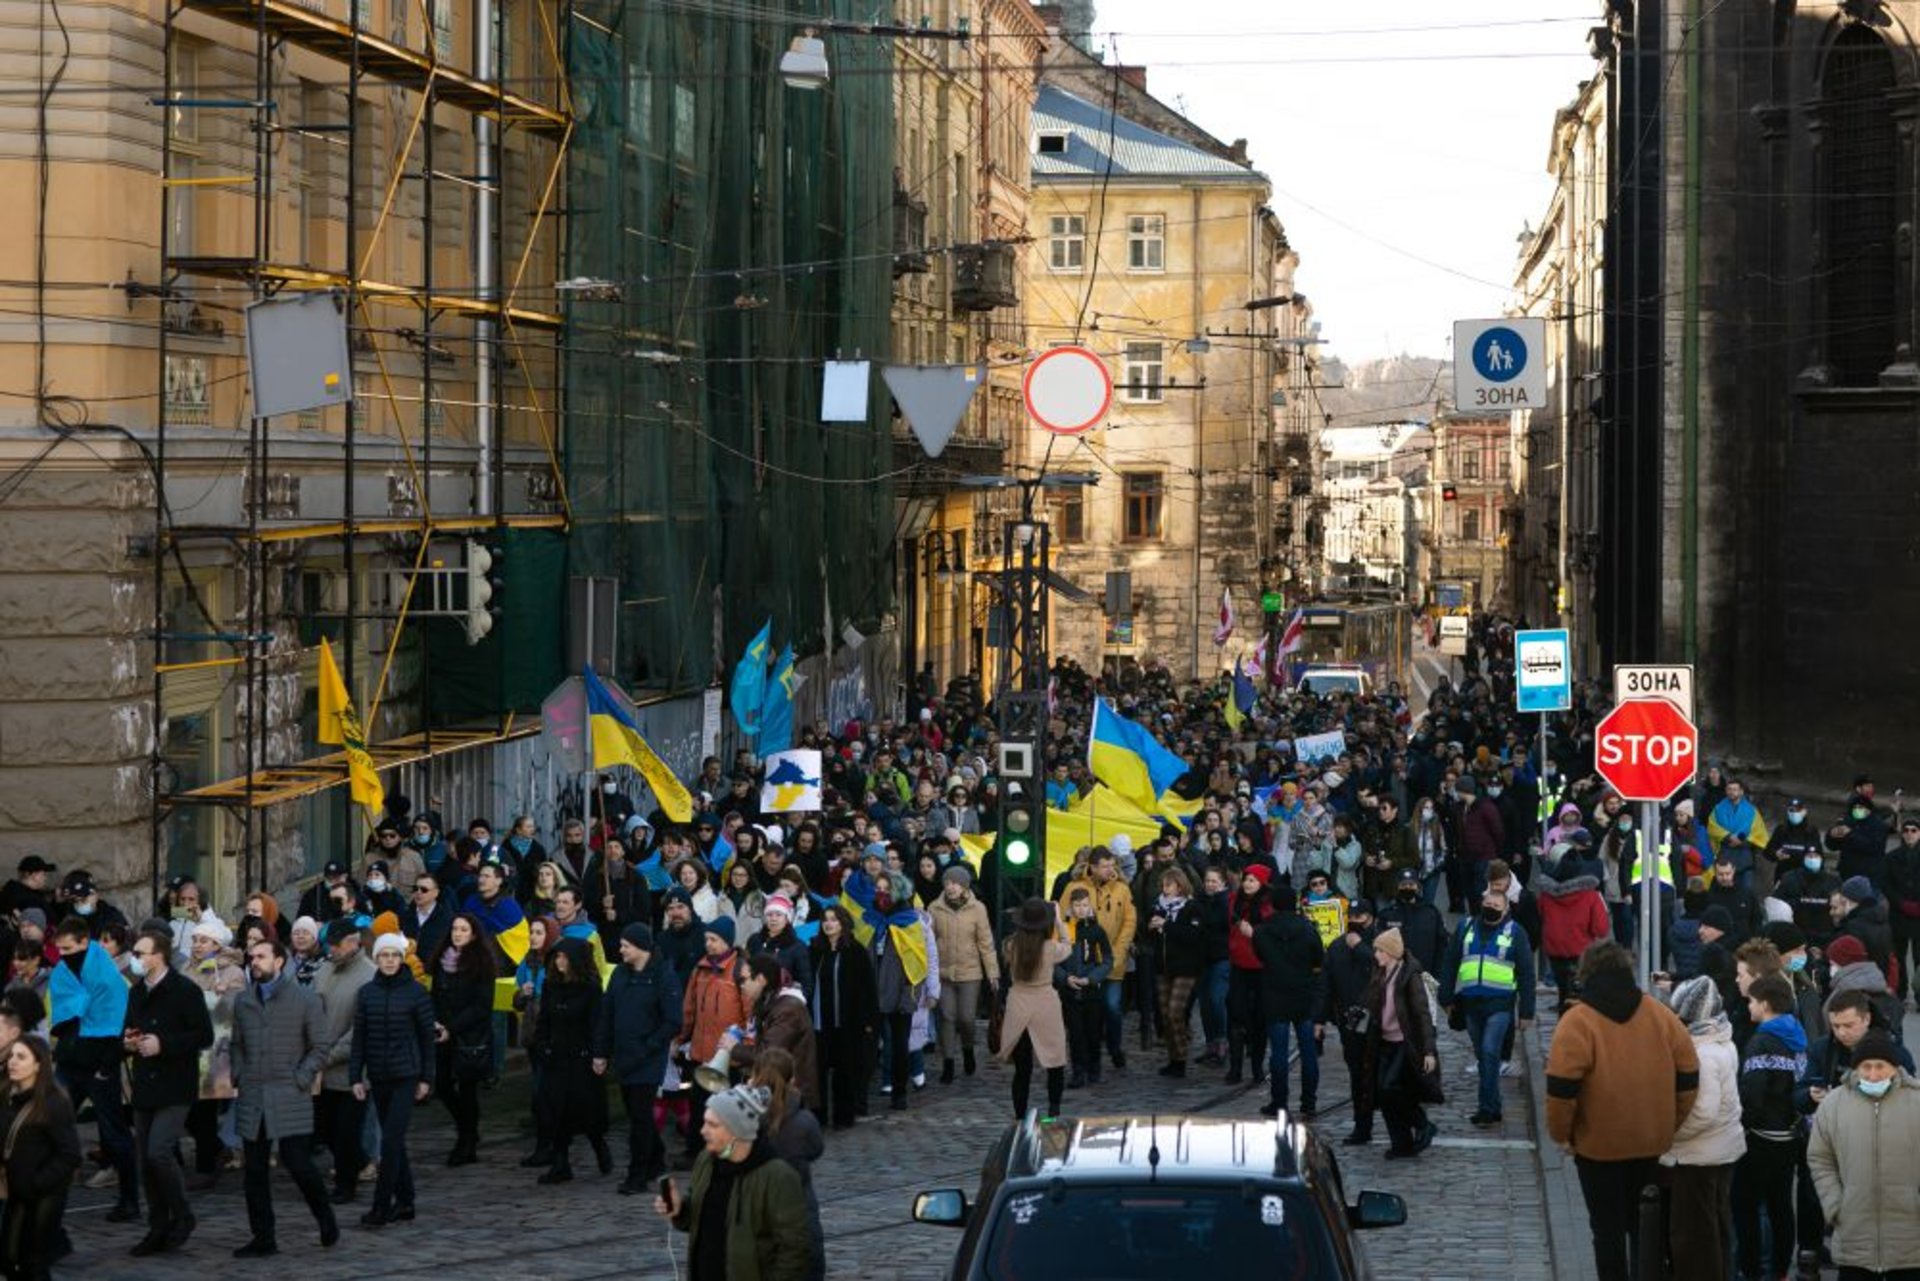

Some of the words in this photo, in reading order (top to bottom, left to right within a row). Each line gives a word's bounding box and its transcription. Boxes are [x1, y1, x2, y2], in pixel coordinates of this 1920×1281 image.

[1475, 388, 1528, 405] ЗОНА
[1628, 672, 1681, 691] ЗОНА
[1601, 733, 1692, 765] STOP
